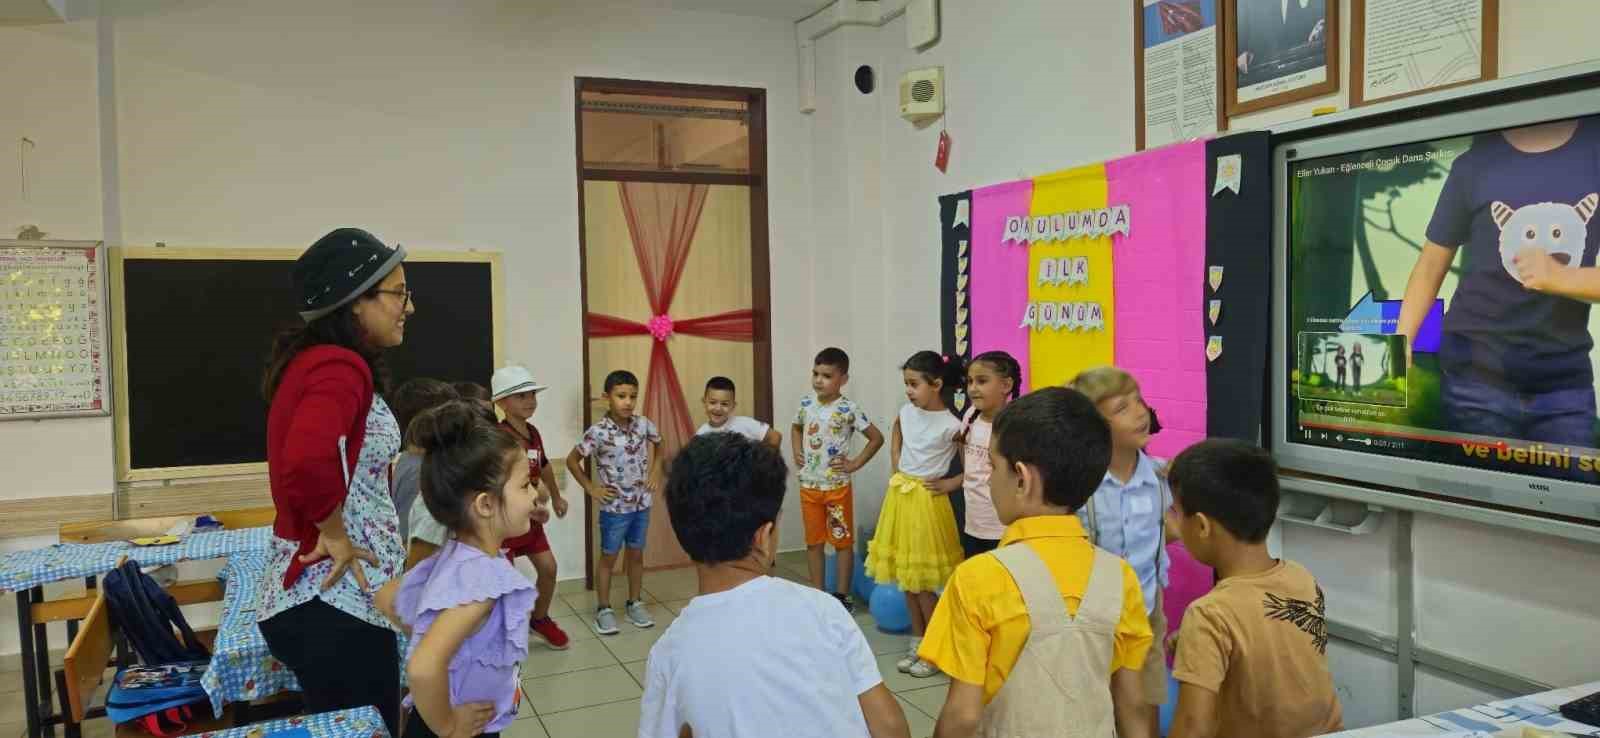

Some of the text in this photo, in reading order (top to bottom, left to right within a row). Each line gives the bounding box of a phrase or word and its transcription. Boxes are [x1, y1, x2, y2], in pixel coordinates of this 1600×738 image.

[1009, 209, 1126, 234] OKULUMDA
[1045, 260, 1085, 278] İLK
[1028, 305, 1101, 321] GÜNÜM
[1461, 441, 1490, 459] ve
[1497, 443, 1570, 469] belini
